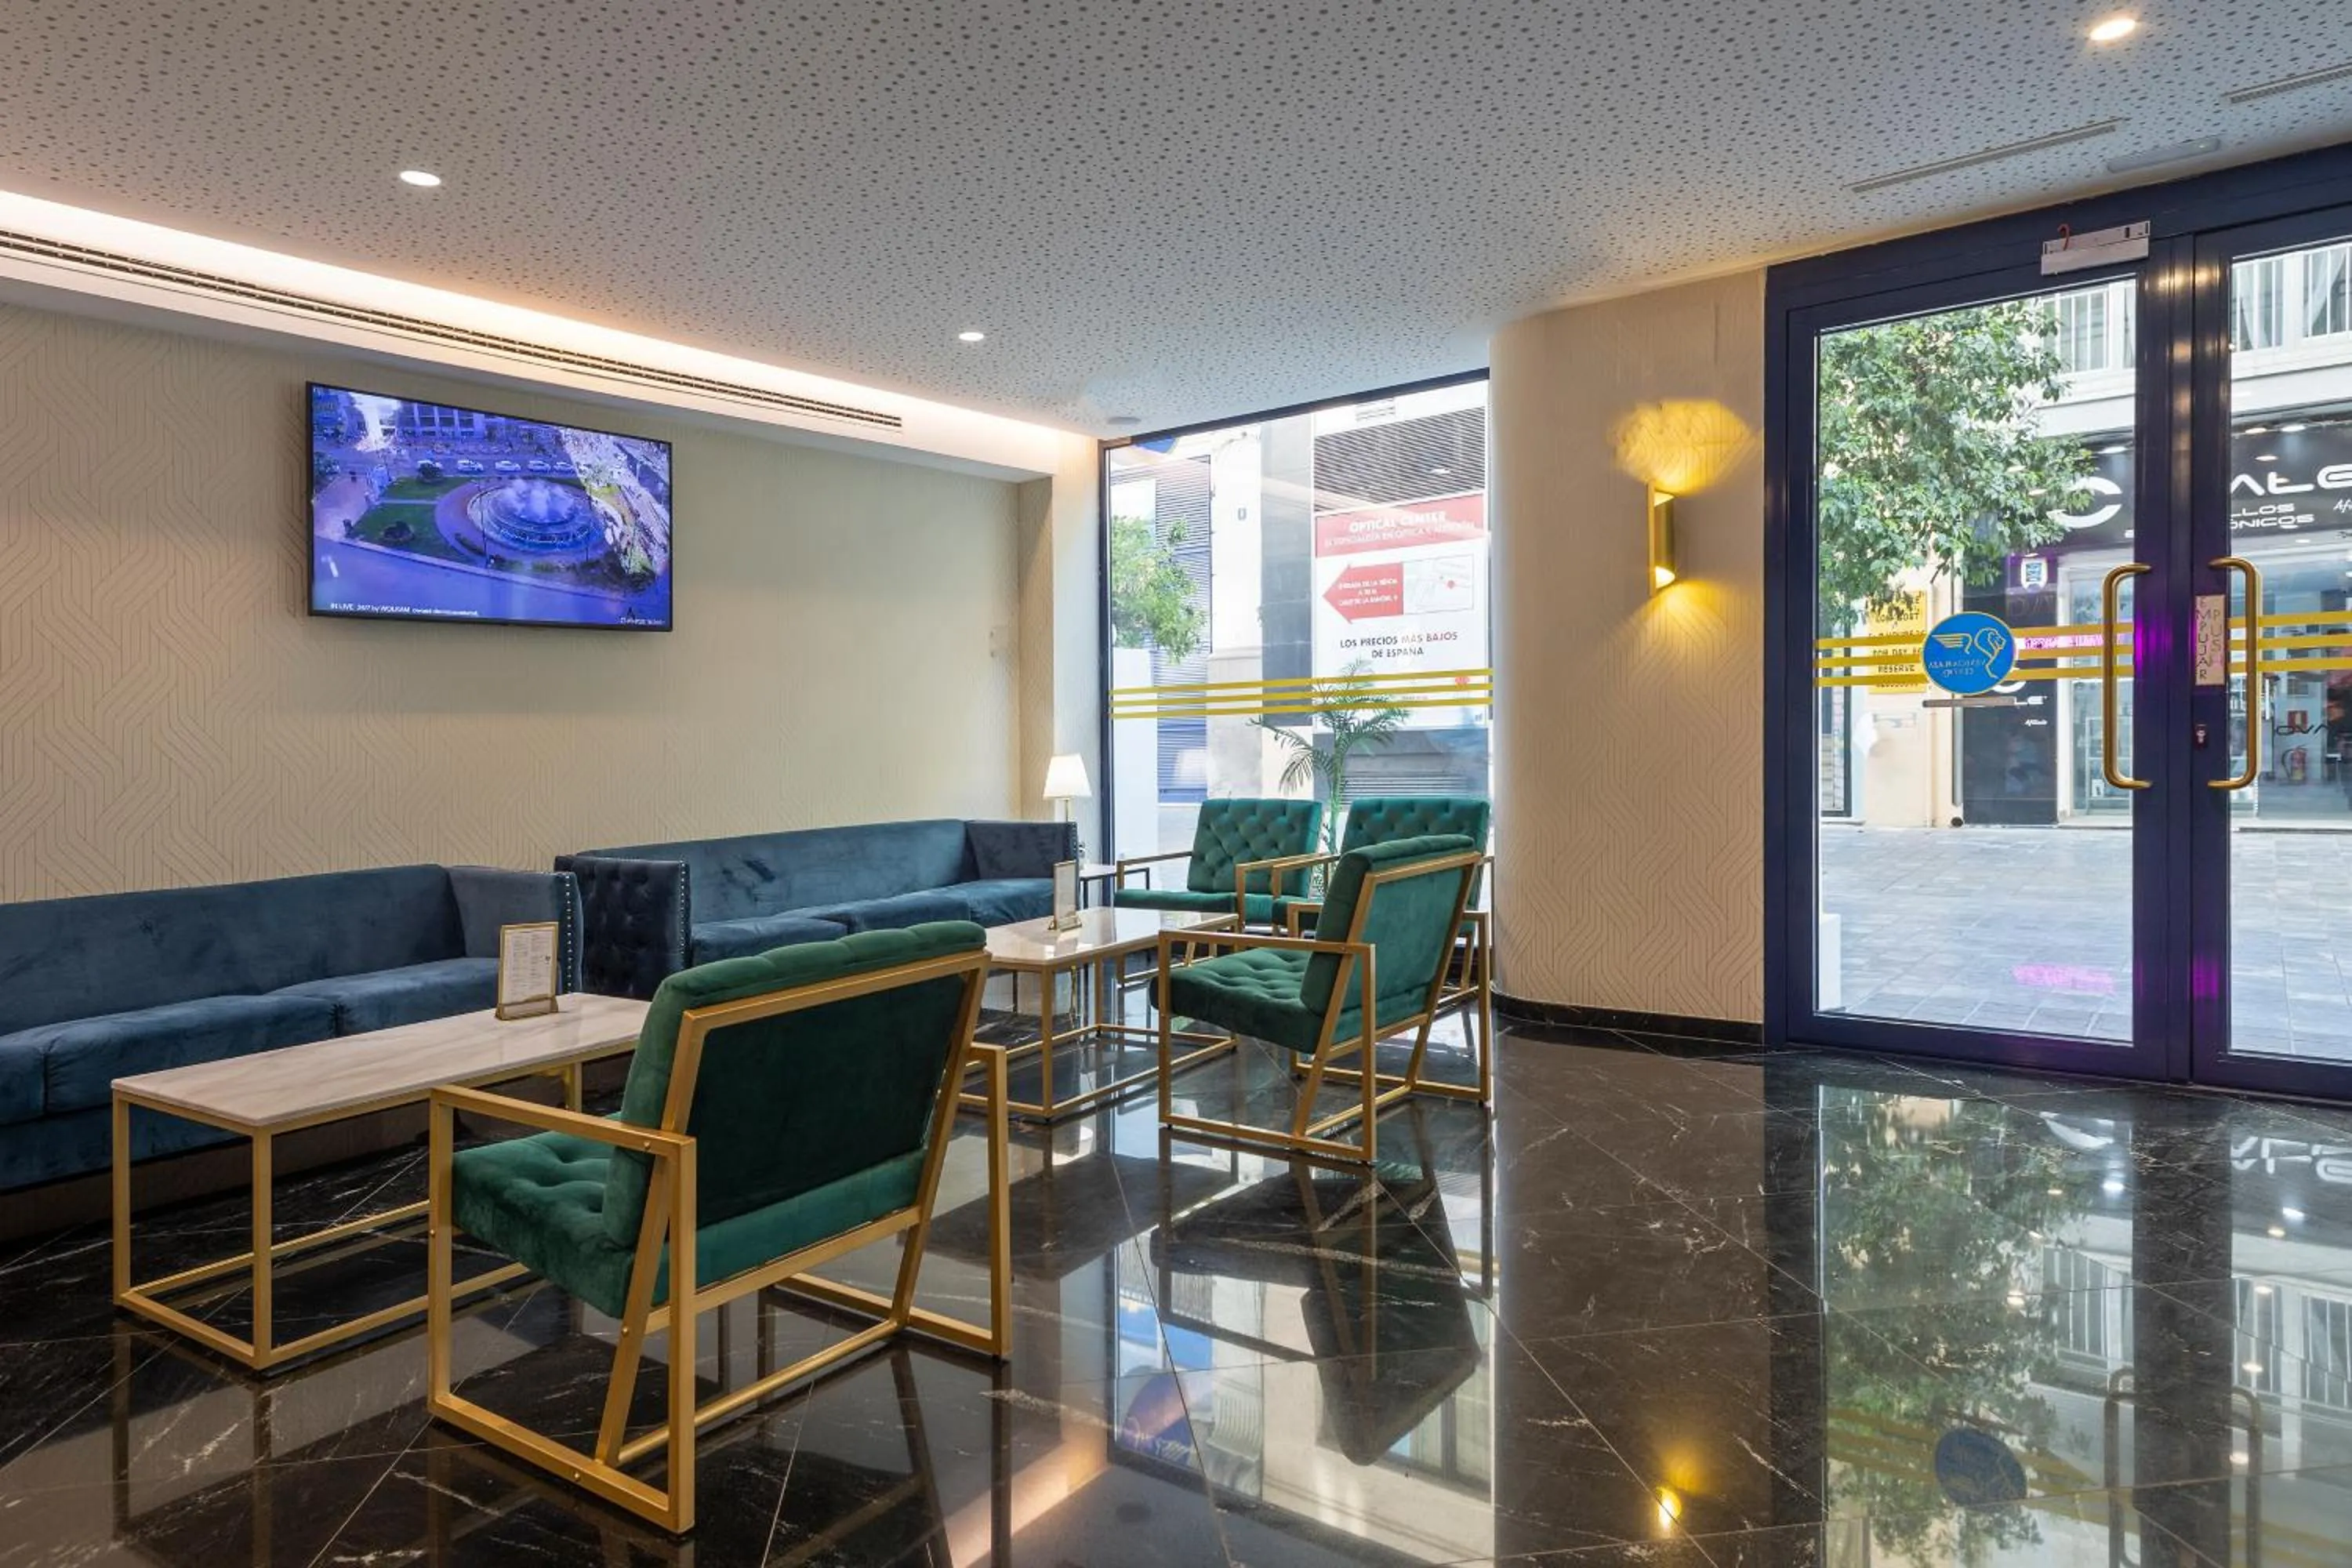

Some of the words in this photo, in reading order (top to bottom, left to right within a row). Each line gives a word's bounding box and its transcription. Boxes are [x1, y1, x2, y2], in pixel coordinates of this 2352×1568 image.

[1350, 518, 1396, 532] OPTICAL
[1402, 511, 1446, 526] CENTER
[1340, 639, 1357, 648] LOS
[1360, 636, 1398, 647] PRECIOS
[1426, 631, 1458, 642] BAJOS
[2196, 597, 2212, 681] EMPUJAR
[2210, 609, 2224, 668] PUSH
[1372, 649, 1383, 658] DE
